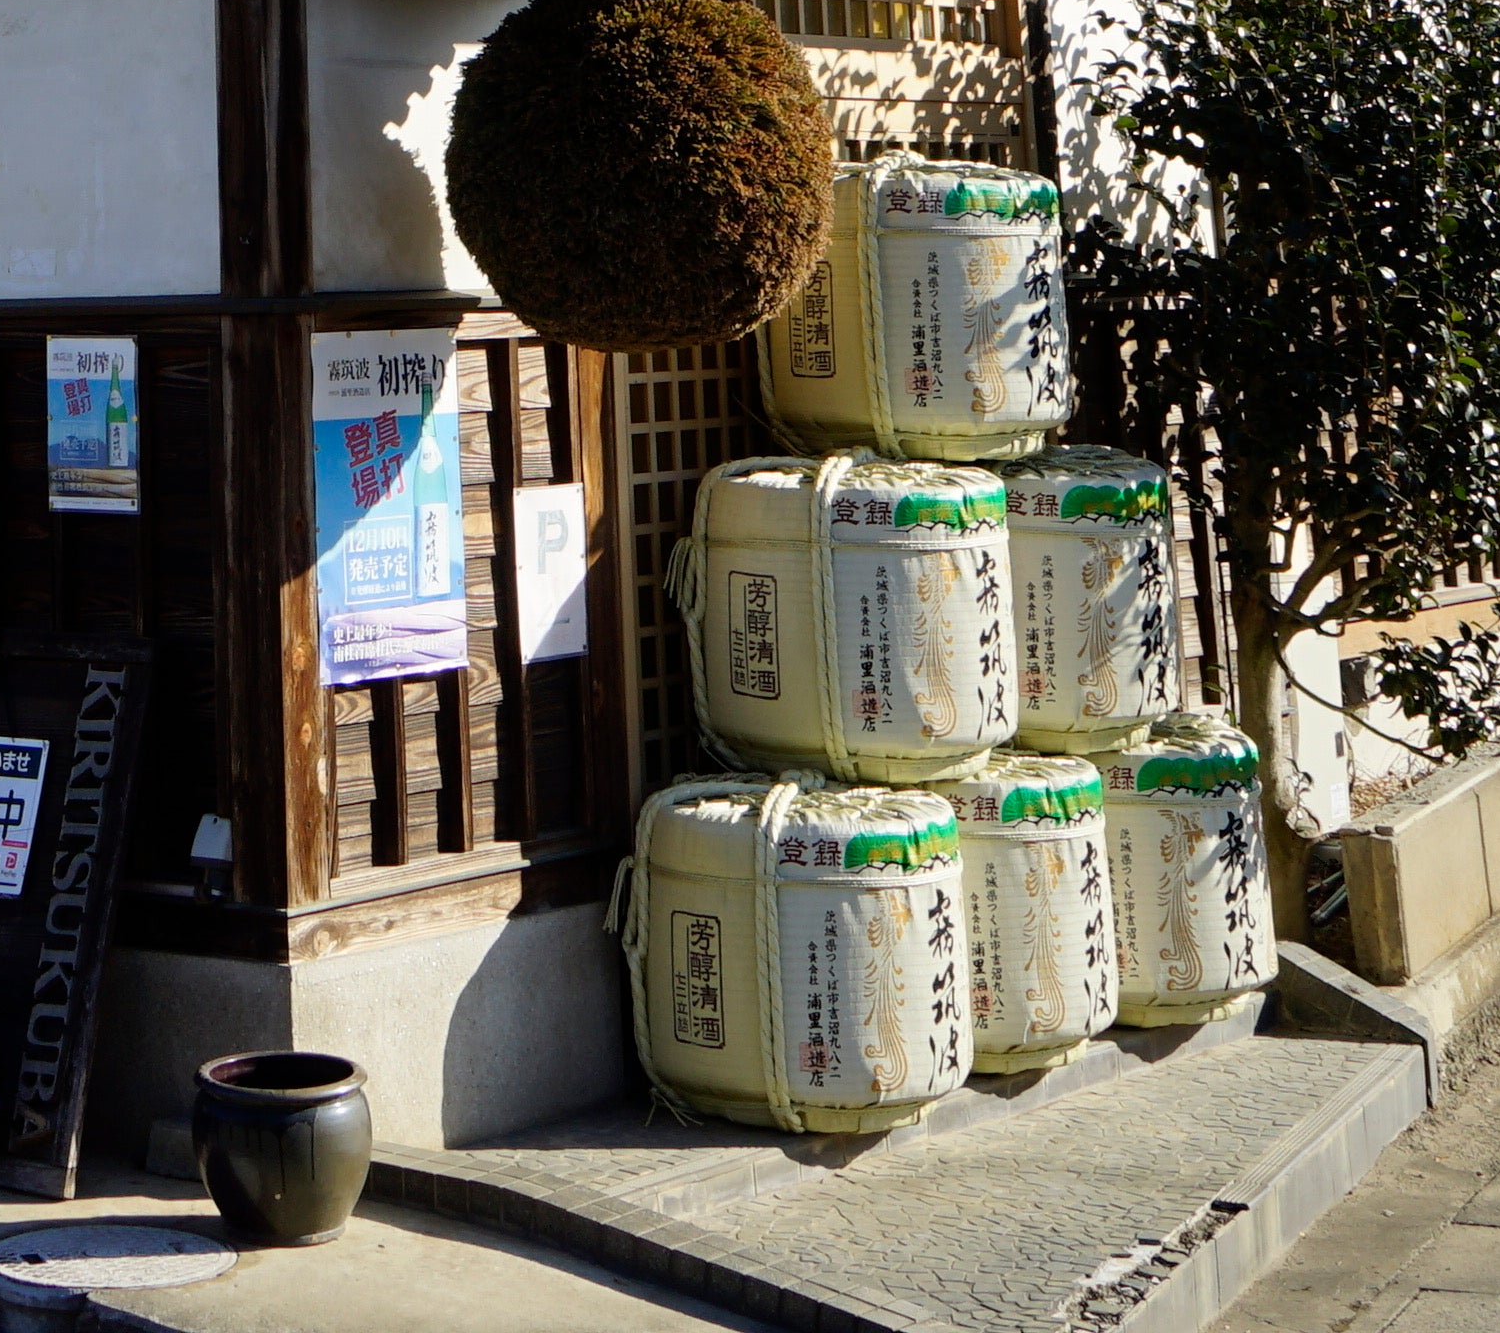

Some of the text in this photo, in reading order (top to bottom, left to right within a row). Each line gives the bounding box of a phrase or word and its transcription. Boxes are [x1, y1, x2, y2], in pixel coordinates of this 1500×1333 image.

[885, 188, 944, 214] 登録
[911, 323, 932, 408] 浦里酒造店
[1023, 239, 1063, 417] 霧筑波
[327, 352, 446, 398] 霧筑波 初搾り
[348, 526, 409, 553] 12月10日
[537, 510, 569, 575] P
[831, 497, 894, 526] 登録
[1006, 489, 1060, 517] 登録
[348, 553, 409, 583] 発売予定
[747, 578, 777, 694] 芳醇清酒
[975, 549, 1009, 741] 霧筑波
[1025, 626, 1043, 711] 浦里酒造店
[1136, 537, 1169, 718] 霧筑波
[859, 643, 879, 733] 浦里酒造店
[1099, 764, 1136, 792] 録
[779, 835, 842, 867] 登録
[12, 662, 129, 1143] KIRITSUKUBA
[1080, 839, 1113, 1036] 霧筑波
[1218, 810, 1261, 992] 霧筑波
[689, 918, 721, 1044] 芳醇清酒
[927, 888, 962, 1094] 霧筑波
[971, 939, 993, 1030] 浦里酒造店
[806, 992, 826, 1088] 浦里酒造店
